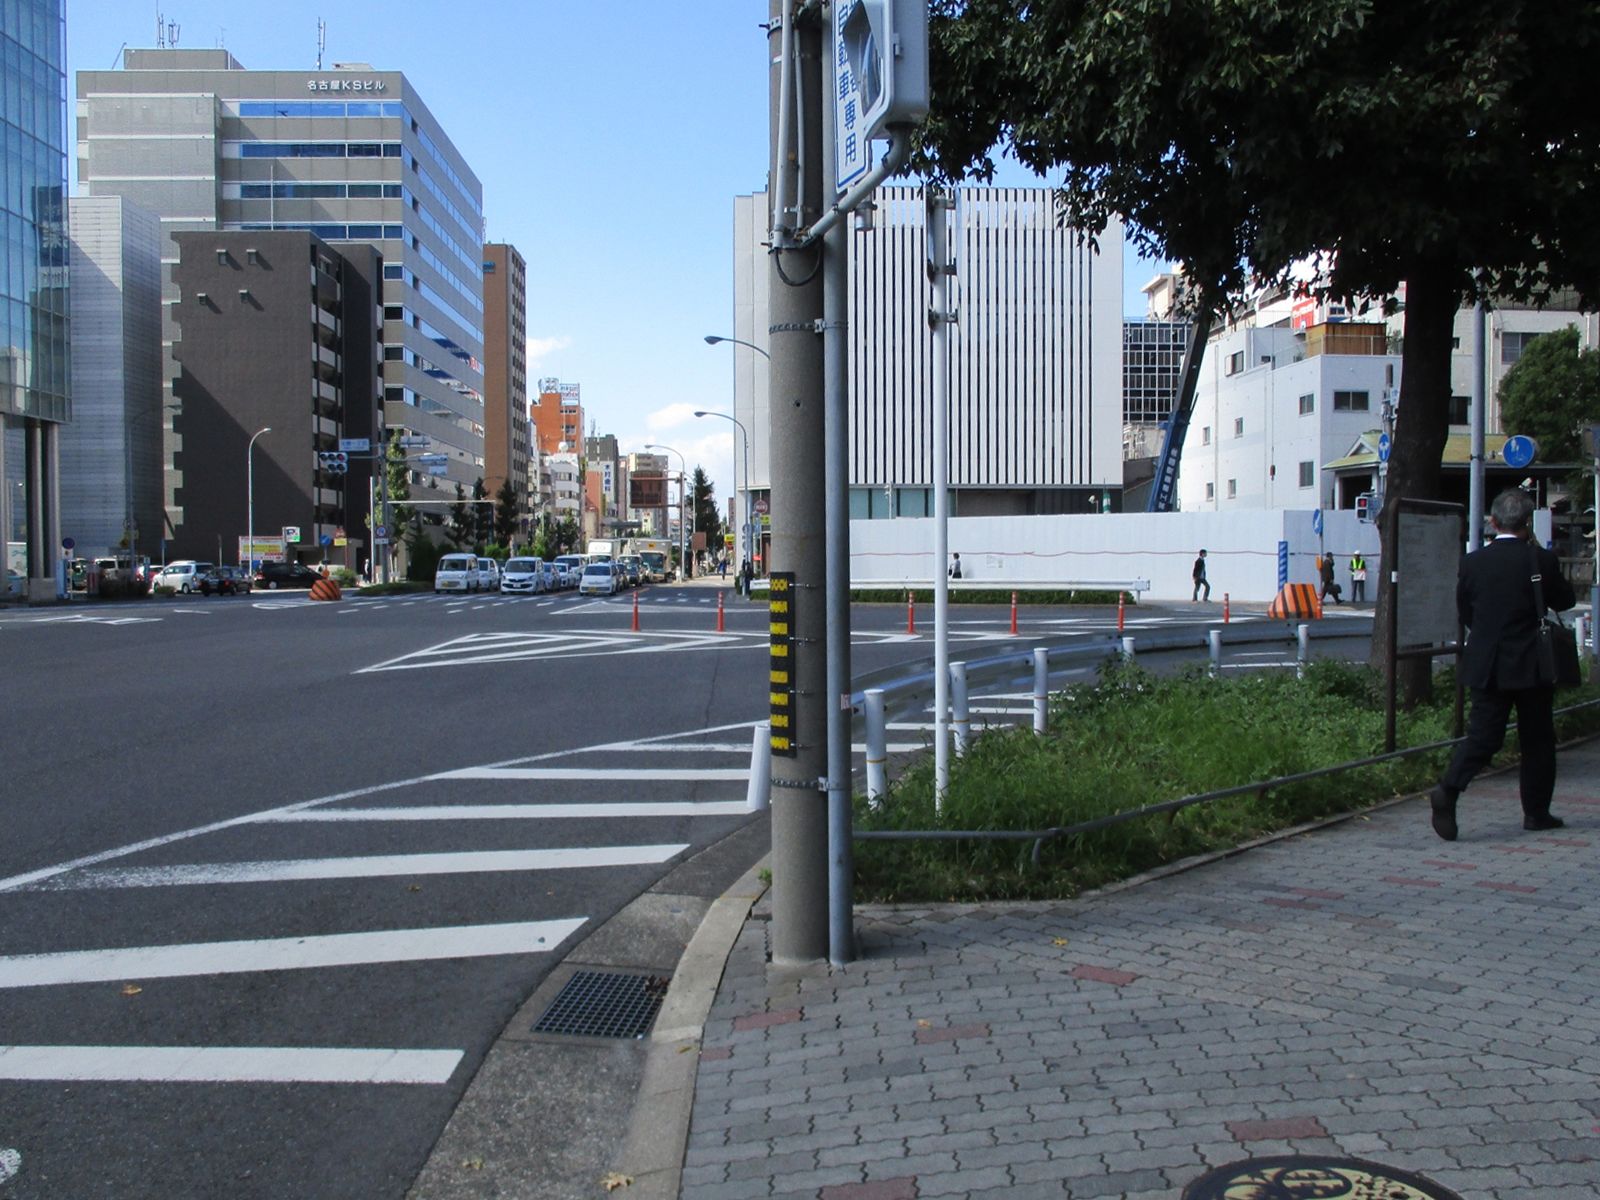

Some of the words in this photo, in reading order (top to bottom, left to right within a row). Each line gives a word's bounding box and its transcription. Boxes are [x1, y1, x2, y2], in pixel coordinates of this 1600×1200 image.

[307, 80, 386, 91] 名古屋KSビル
